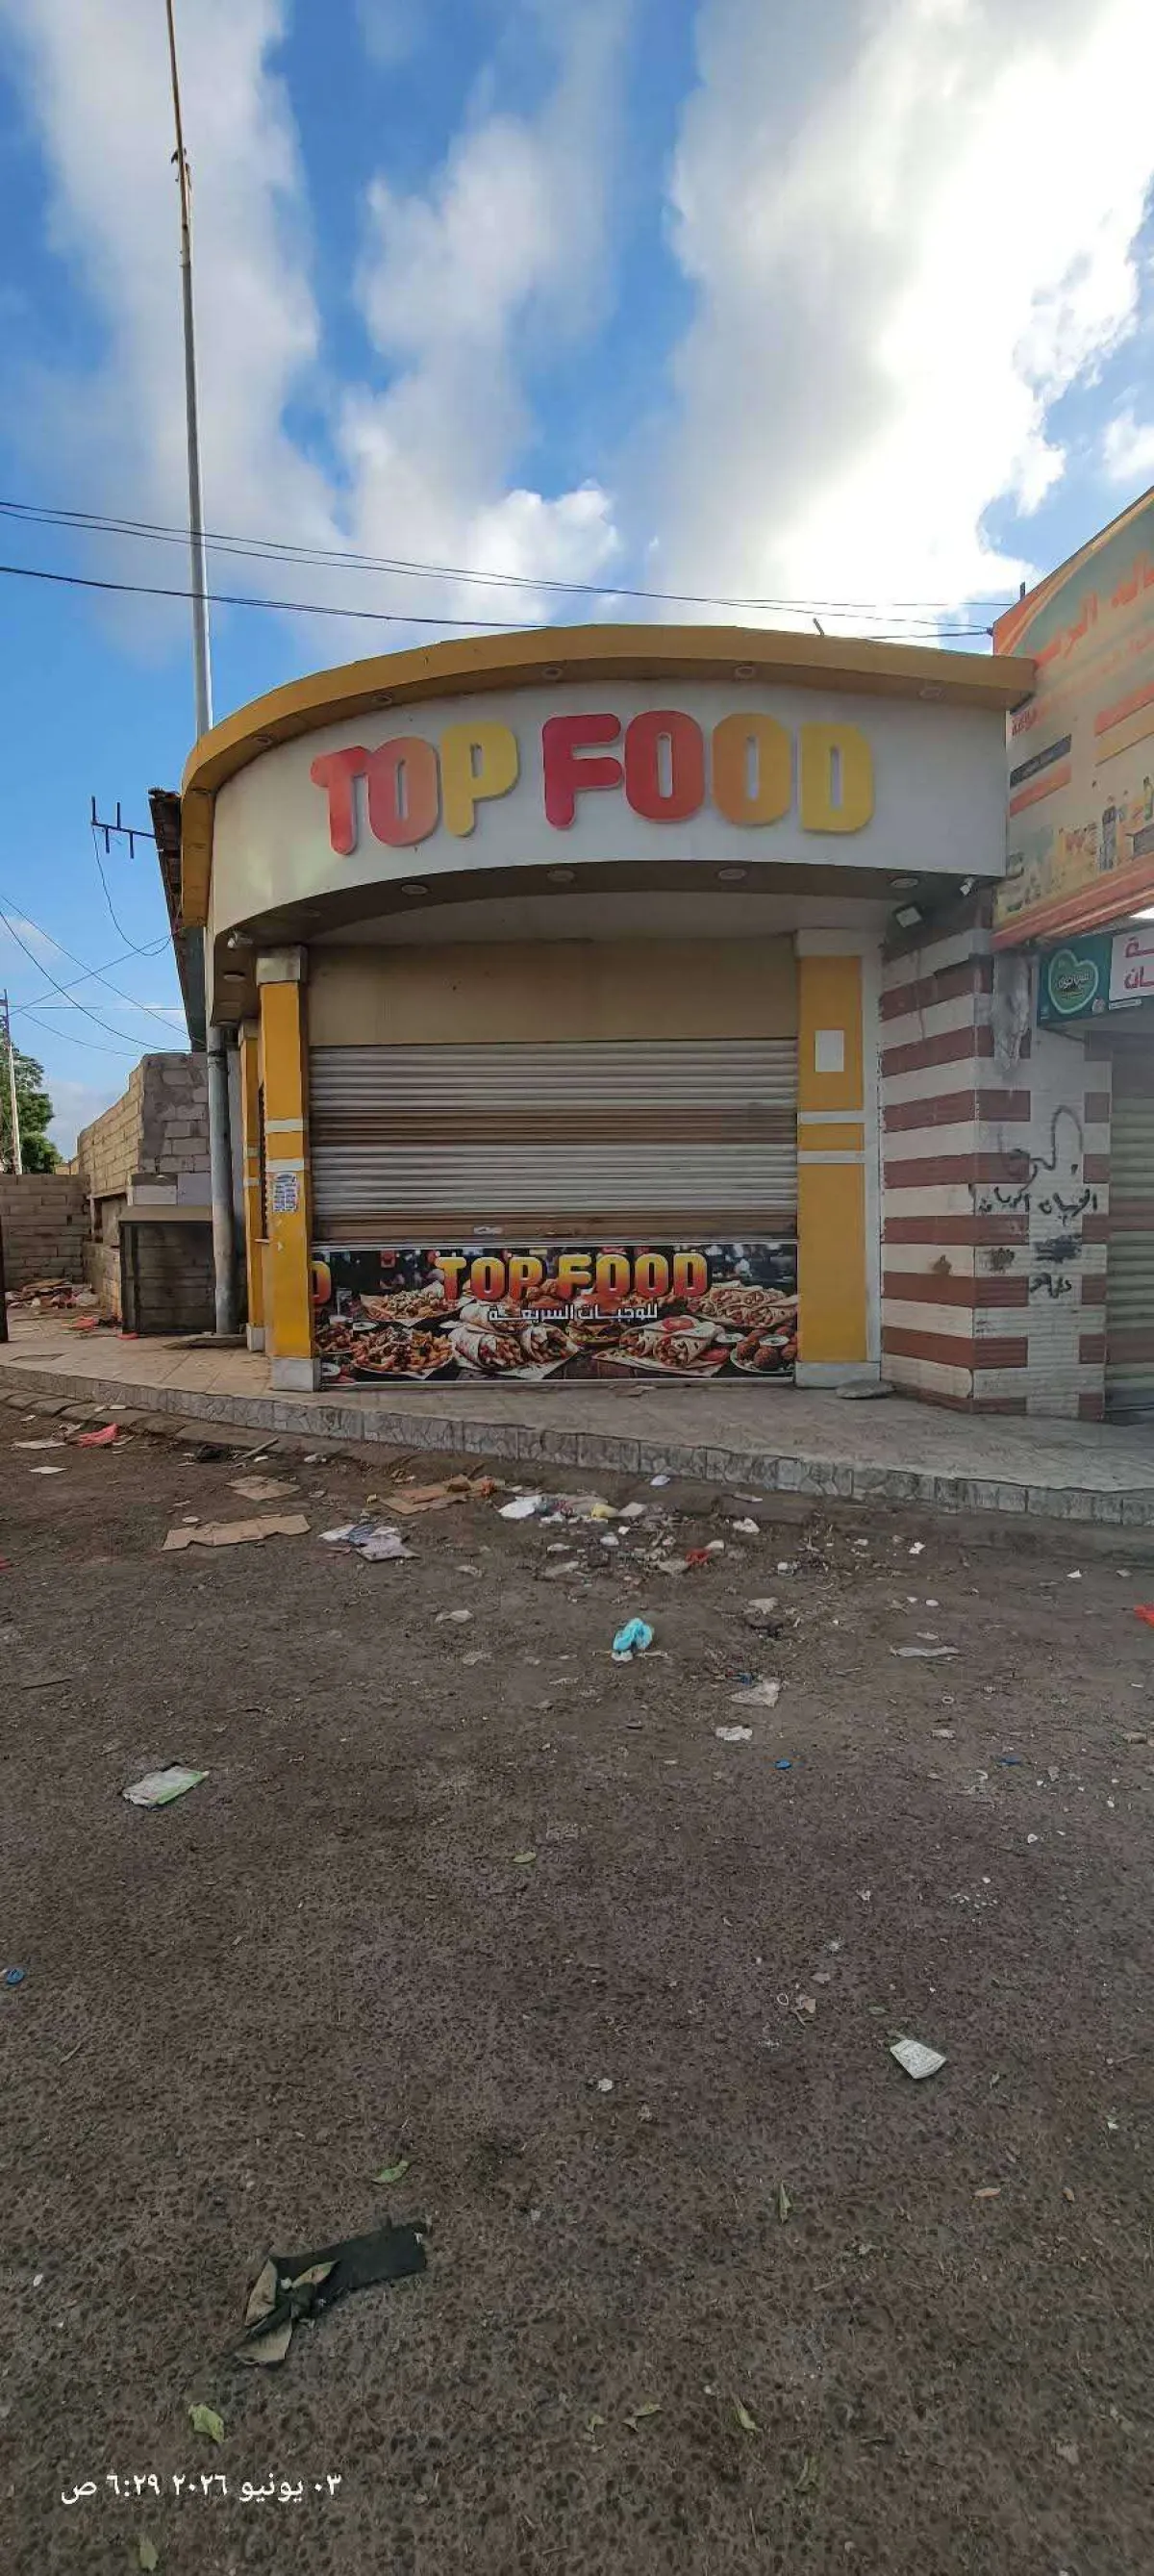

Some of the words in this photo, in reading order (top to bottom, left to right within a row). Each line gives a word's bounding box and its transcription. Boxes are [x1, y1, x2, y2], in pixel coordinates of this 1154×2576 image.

[311, 721, 521, 856] TOP
[541, 710, 875, 835] FOOD
[436, 1255, 544, 1301] TOP
[556, 1252, 709, 1299] FOOD
